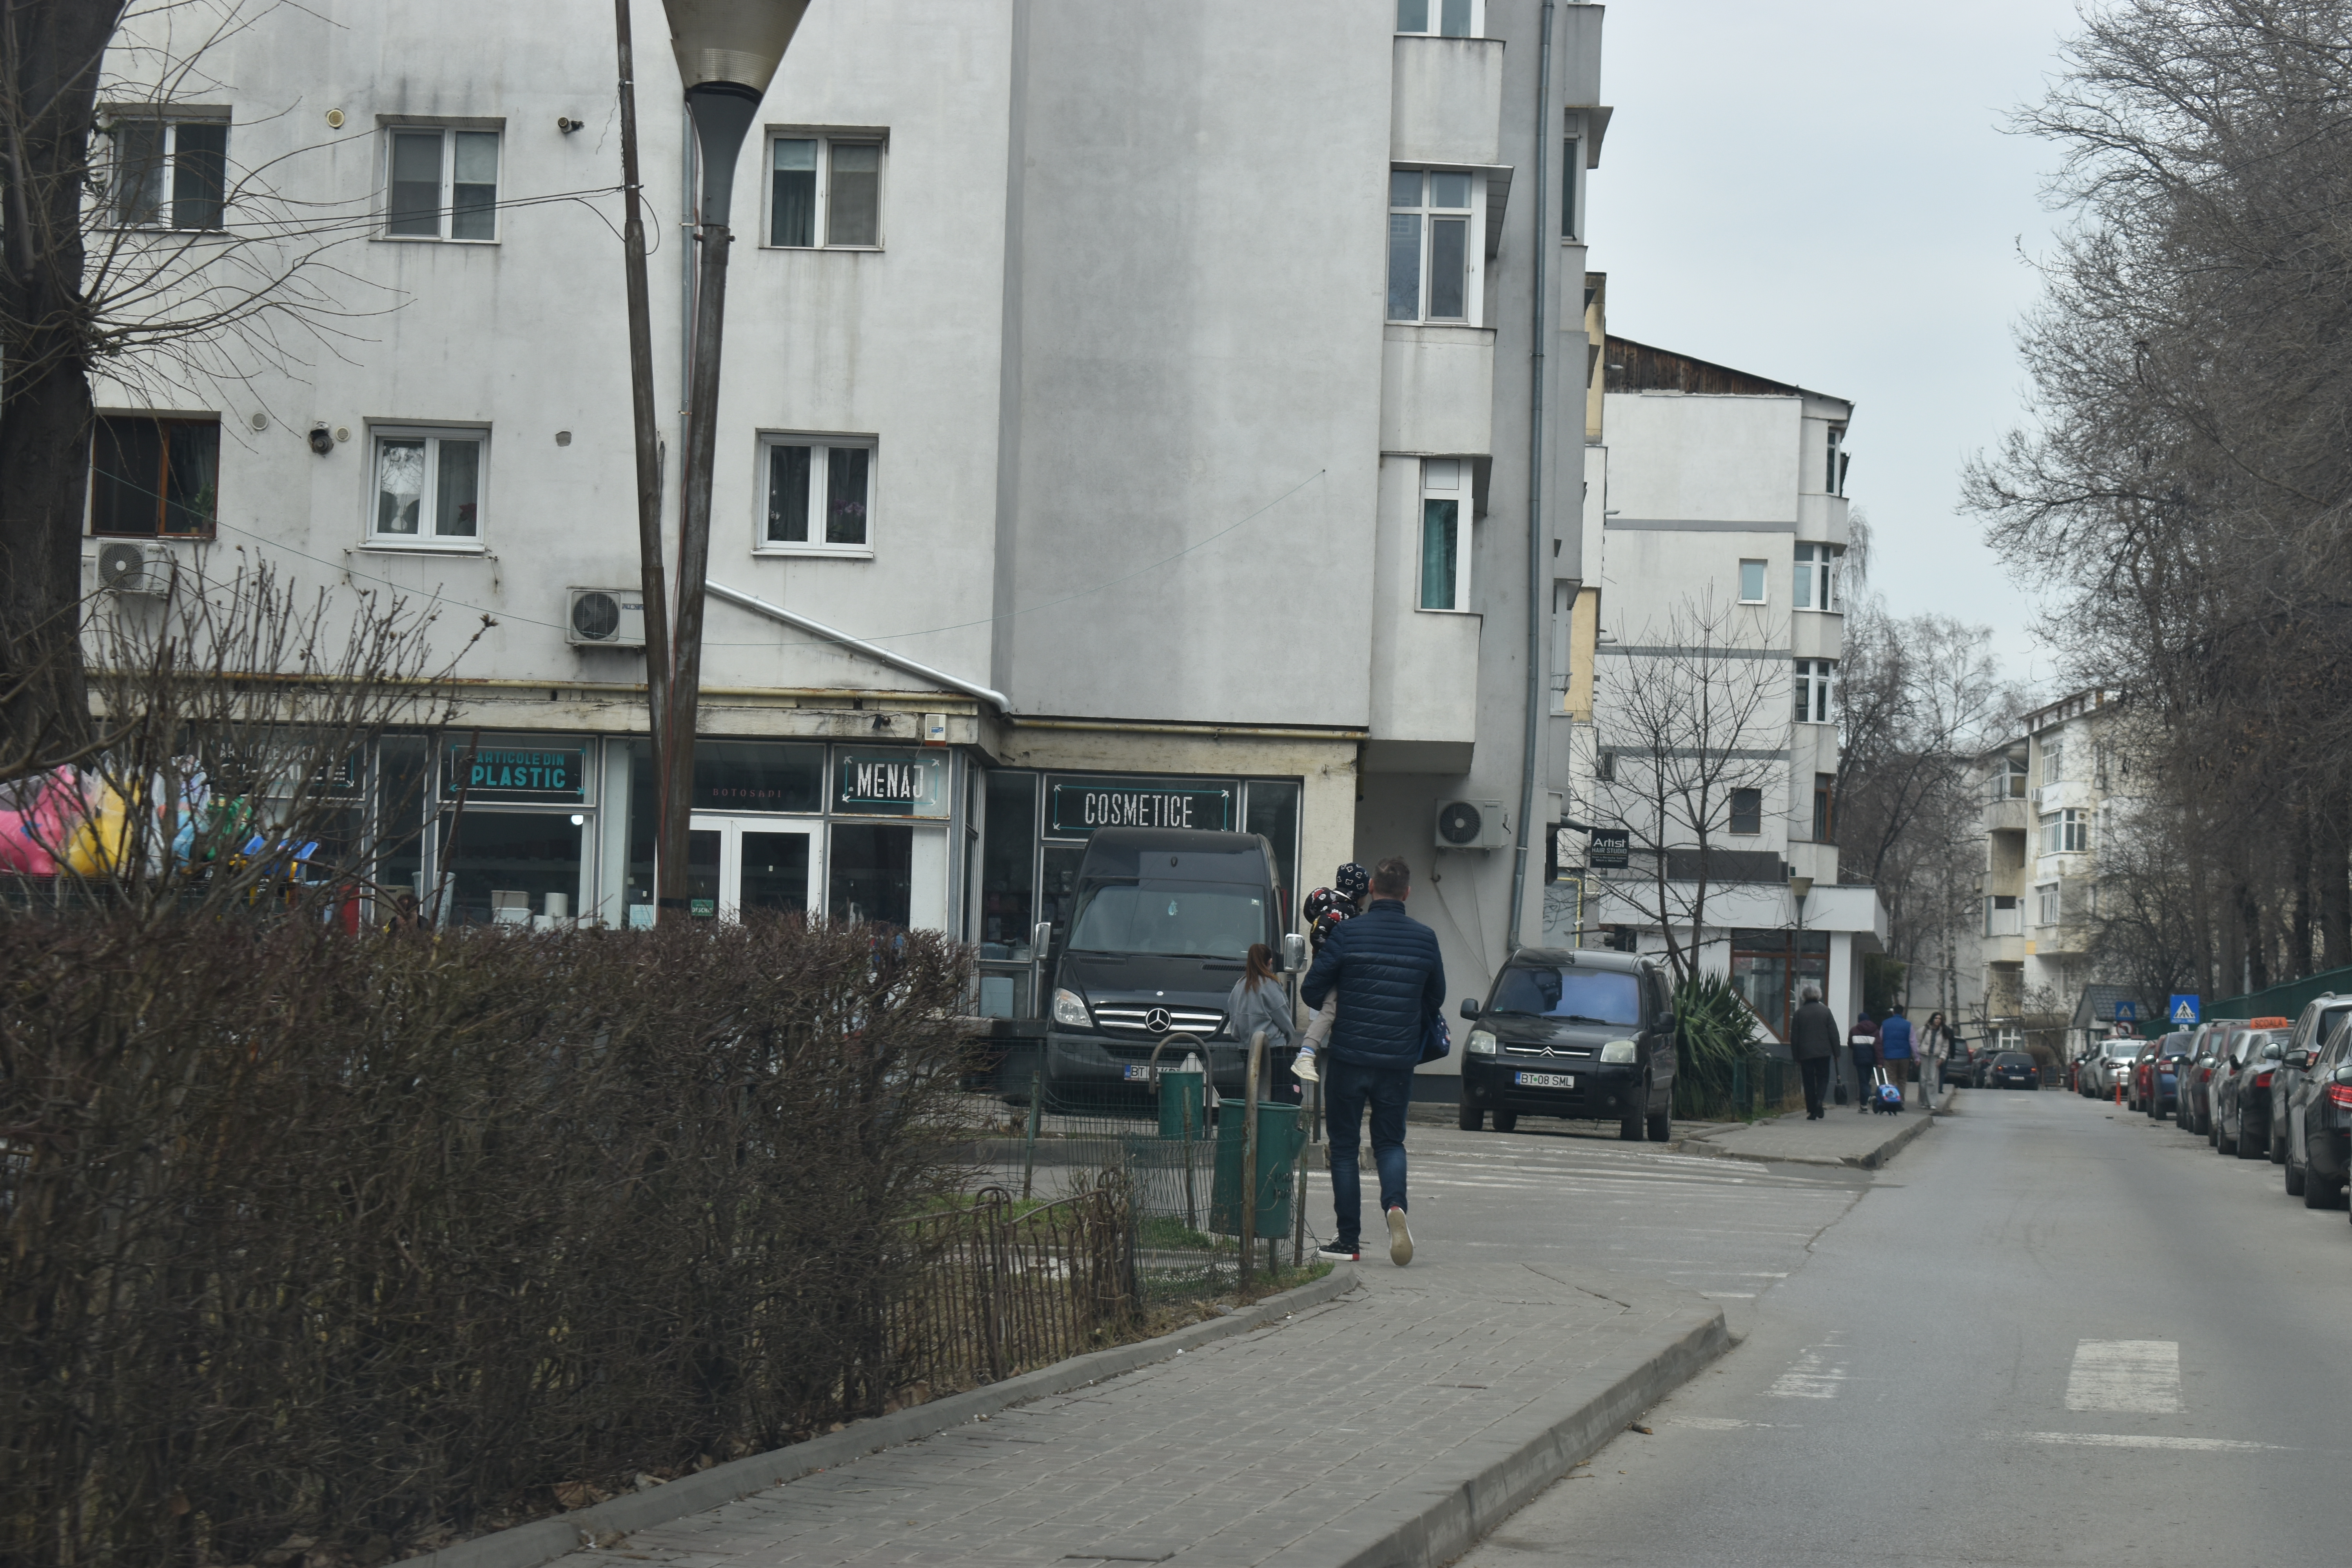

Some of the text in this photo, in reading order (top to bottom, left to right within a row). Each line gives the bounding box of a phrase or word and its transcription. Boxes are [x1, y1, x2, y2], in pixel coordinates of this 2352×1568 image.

[220, 743, 280, 759] ARICOLE
[476, 751, 564, 765] ARTICOLE DIN
[472, 765, 565, 788] PLASTIC
[857, 763, 924, 798] MENAJ
[1085, 793, 1192, 828] COSMETICE
[1593, 838, 1626, 848] Artist
[1131, 1067, 1145, 1077] BT
[1521, 1074, 1534, 1083] BT
[1538, 1075, 1549, 1084] 08
[1552, 1076, 1571, 1086] SML
